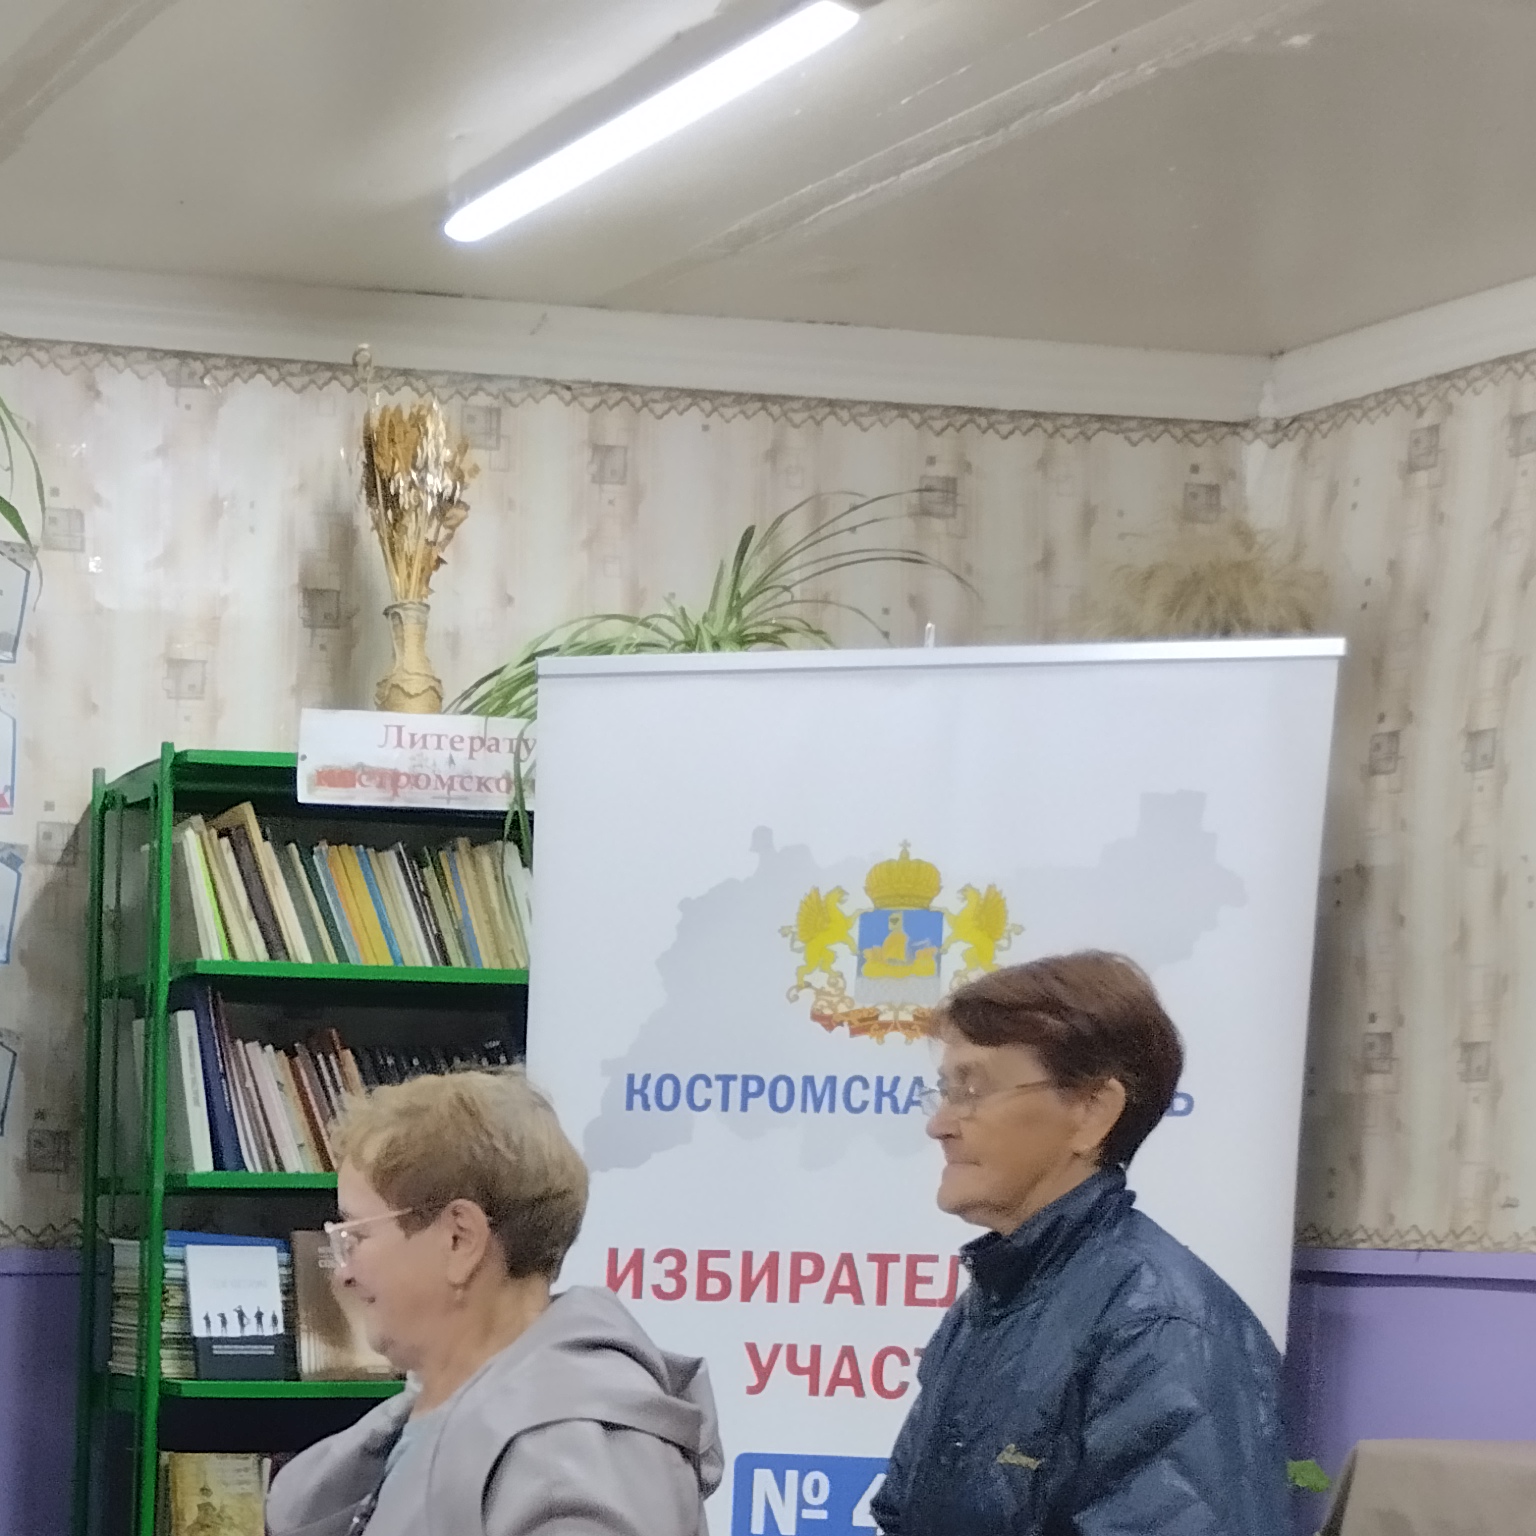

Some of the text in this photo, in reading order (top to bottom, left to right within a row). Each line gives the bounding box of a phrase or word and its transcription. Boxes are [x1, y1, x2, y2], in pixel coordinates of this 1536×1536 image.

[378, 723, 538, 763] Литерату
[625, 1072, 927, 1115] КОСТРОМСКА
[606, 1247, 962, 1308] ИЗБИРАТЕЛ
[744, 1341, 926, 1400] УЧАС
[750, 1468, 830, 1536] №
